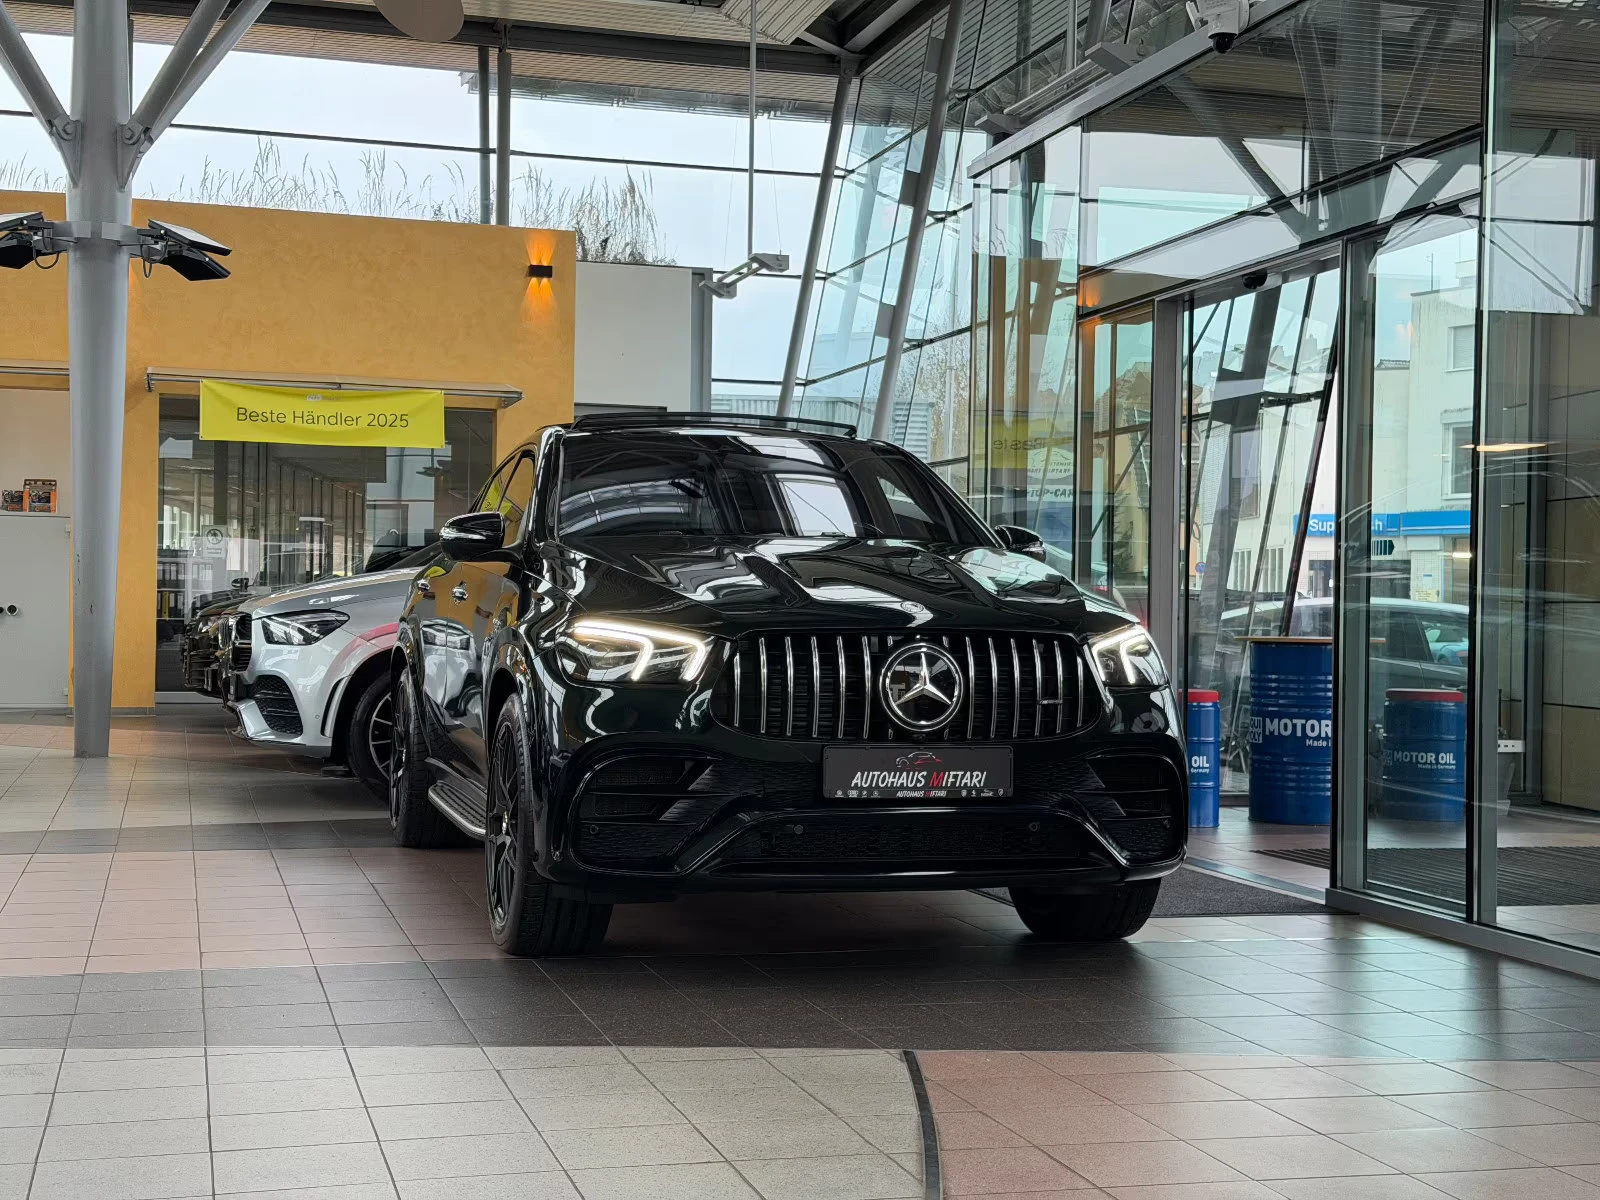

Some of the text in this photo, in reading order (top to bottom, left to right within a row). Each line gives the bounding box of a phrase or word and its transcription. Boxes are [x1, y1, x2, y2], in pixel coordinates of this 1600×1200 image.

[236, 407, 409, 428] Beste Händler 2025
[1265, 718, 1331, 738] MOTOR
[1306, 739, 1327, 747] Made
[1191, 756, 1210, 768] OIL
[1393, 751, 1436, 764] MOTOR
[1438, 752, 1456, 764] OIL
[851, 771, 987, 788] AUTOHAUS MIFTARI
[896, 790, 947, 798] AUTOHAUS MIFTARI
